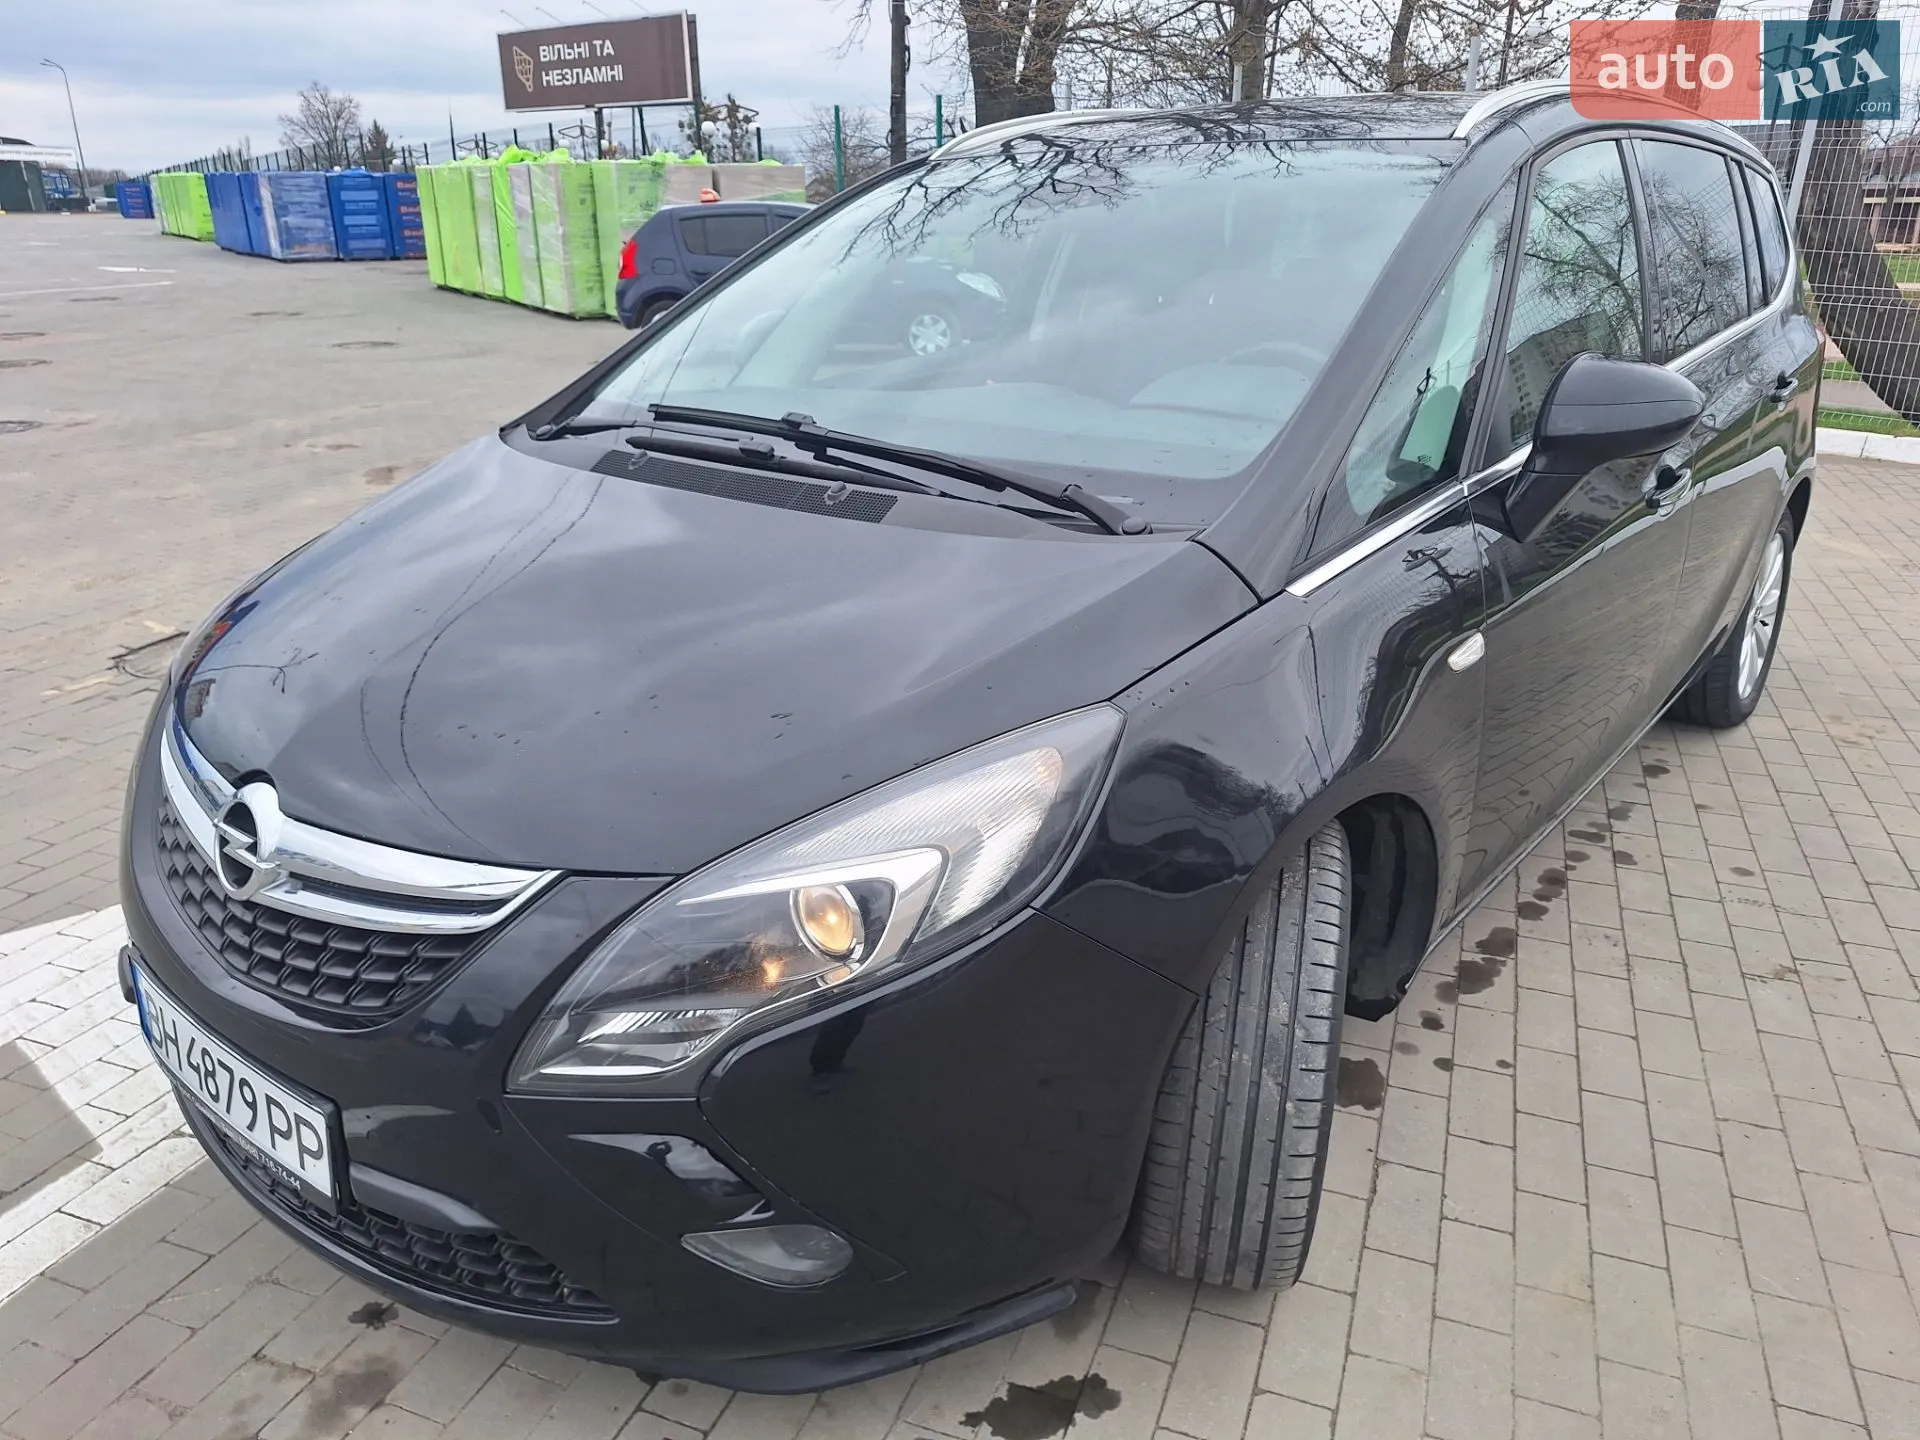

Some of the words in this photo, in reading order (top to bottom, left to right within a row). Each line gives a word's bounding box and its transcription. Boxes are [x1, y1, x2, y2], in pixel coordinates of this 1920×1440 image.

[539, 40, 590, 62] ВІЛЬНІ
[592, 39, 615, 57] ТА
[541, 64, 624, 87] НЕЗЛАМНІ
[186, 1036, 258, 1132] 4879
[265, 1093, 324, 1171] PP
